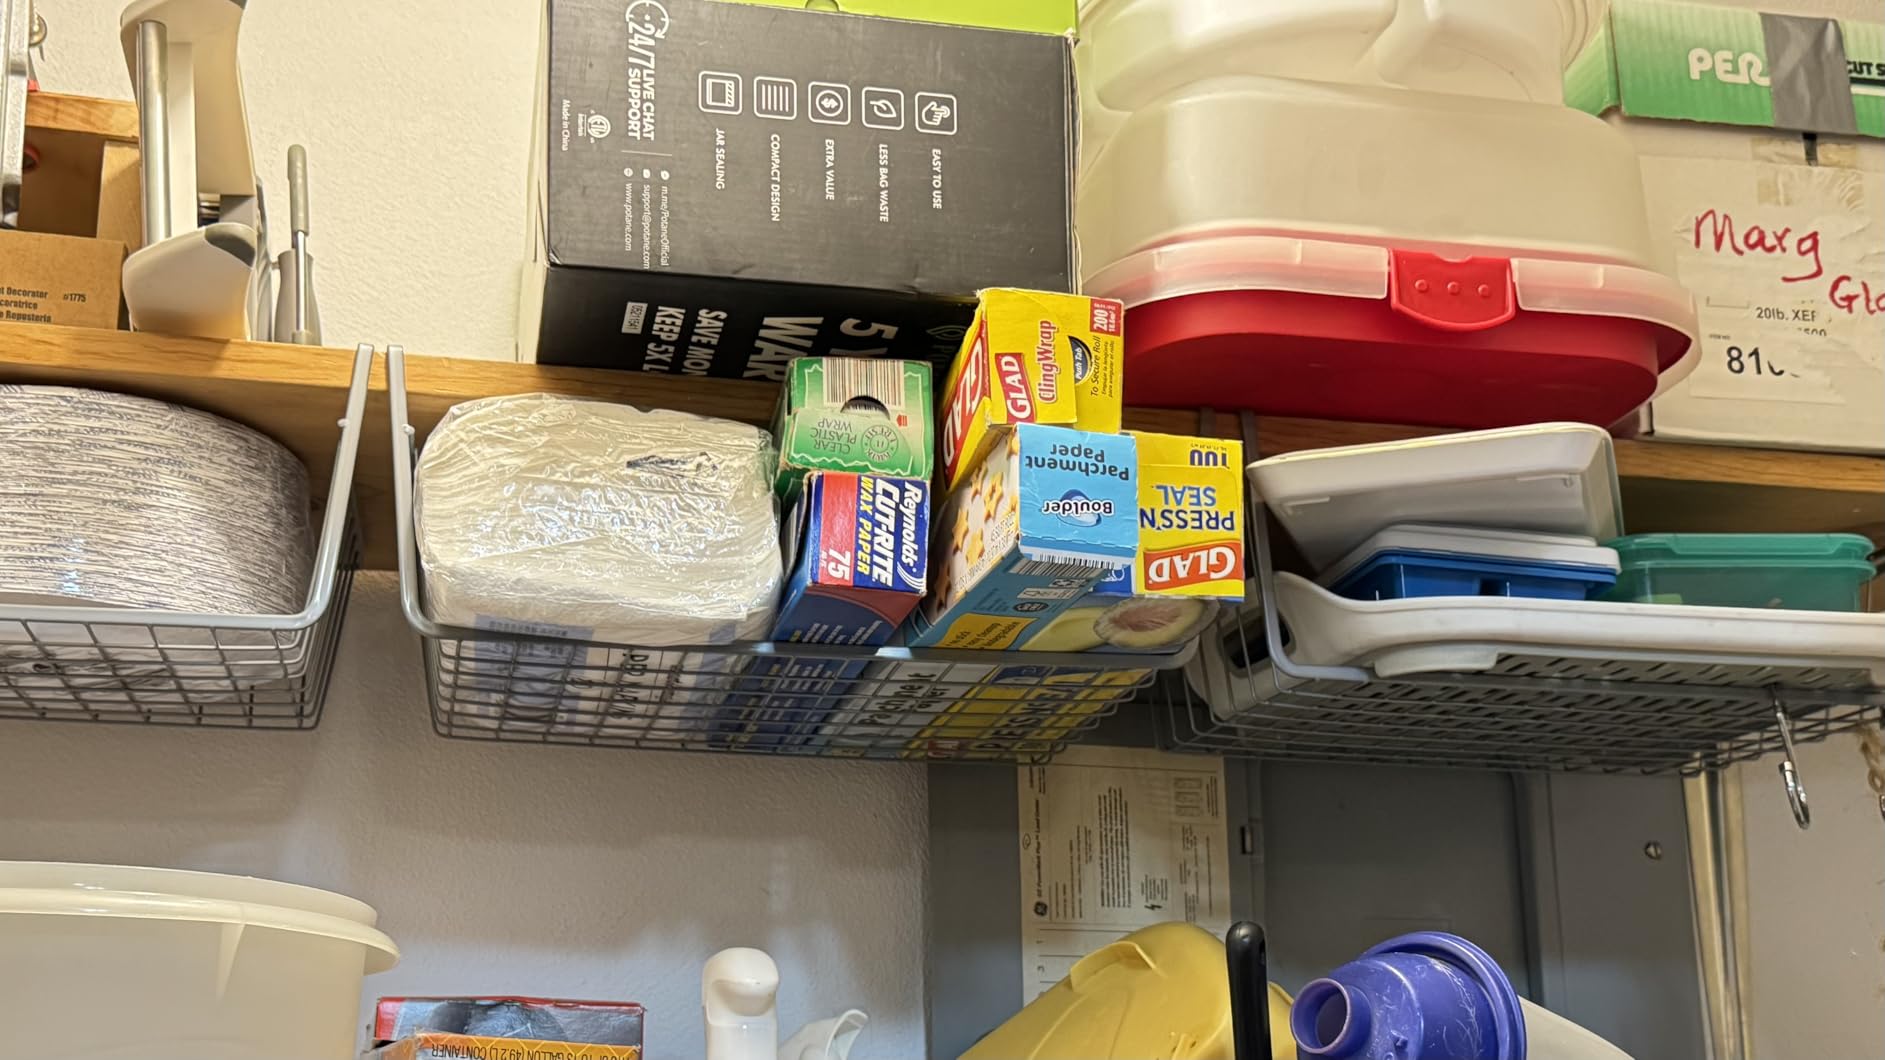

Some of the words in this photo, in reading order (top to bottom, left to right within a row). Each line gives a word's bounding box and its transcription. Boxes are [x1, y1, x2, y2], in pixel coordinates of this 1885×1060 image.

[628, 22, 655, 70] 24/7
[643, 69, 655, 100] LIVE
[562, 99, 571, 119] Made
[628, 67, 641, 140] SUPPORT
[642, 102, 655, 141] CHAT
[562, 130, 570, 151] China
[715, 128, 725, 146] JAR
[771, 133, 780, 183] COMPACT
[825, 138, 835, 168] EXTRA
[878, 143, 888, 166] LESS
[932, 148, 942, 173] EASY
[715, 147, 725, 190] SEALING
[879, 167, 888, 188] BAG
[932, 174, 942, 189] TO
[825, 169, 835, 201] VALUE
[932, 190, 942, 210] USE
[623, 183, 633, 252] www.potane.com
[771, 184, 780, 222] DESIGN
[879, 189, 889, 223] WASTE
[641, 184, 652, 270] support@potane.com
[660, 185, 670, 267] m.me/PotaneOfficial
[1692, 208, 1824, 283] Marg
[651, 305, 686, 342] KEEP
[691, 308, 728, 346] SAVE
[839, 317, 899, 340] 5
[1093, 309, 1109, 331] 200
[645, 342, 675, 363] 5X
[1074, 346, 1083, 361] Tab
[1092, 336, 1101, 354] Roll
[1074, 362, 1083, 380] Push
[1090, 354, 1100, 385] Secure
[1001, 354, 1032, 420] GLAD
[1090, 386, 1099, 397] To
[810, 427, 857, 445] PLASTIC
[817, 417, 854, 433] WRAP
[813, 438, 851, 455] CLEAR
[1050, 443, 1105, 463] Paper
[1025, 454, 1130, 481] Parchment
[860, 475, 874, 515] WAX
[1042, 500, 1114, 518] Boulder
[1155, 485, 1216, 507] SEAL
[871, 478, 900, 587] CUT-RITE
[899, 480, 923, 568] Reynolds
[857, 517, 872, 576] PAPER
[827, 548, 851, 581] 75
[1149, 546, 1236, 584] GLAD
[432, 1043, 487, 1060] CONTAINER
